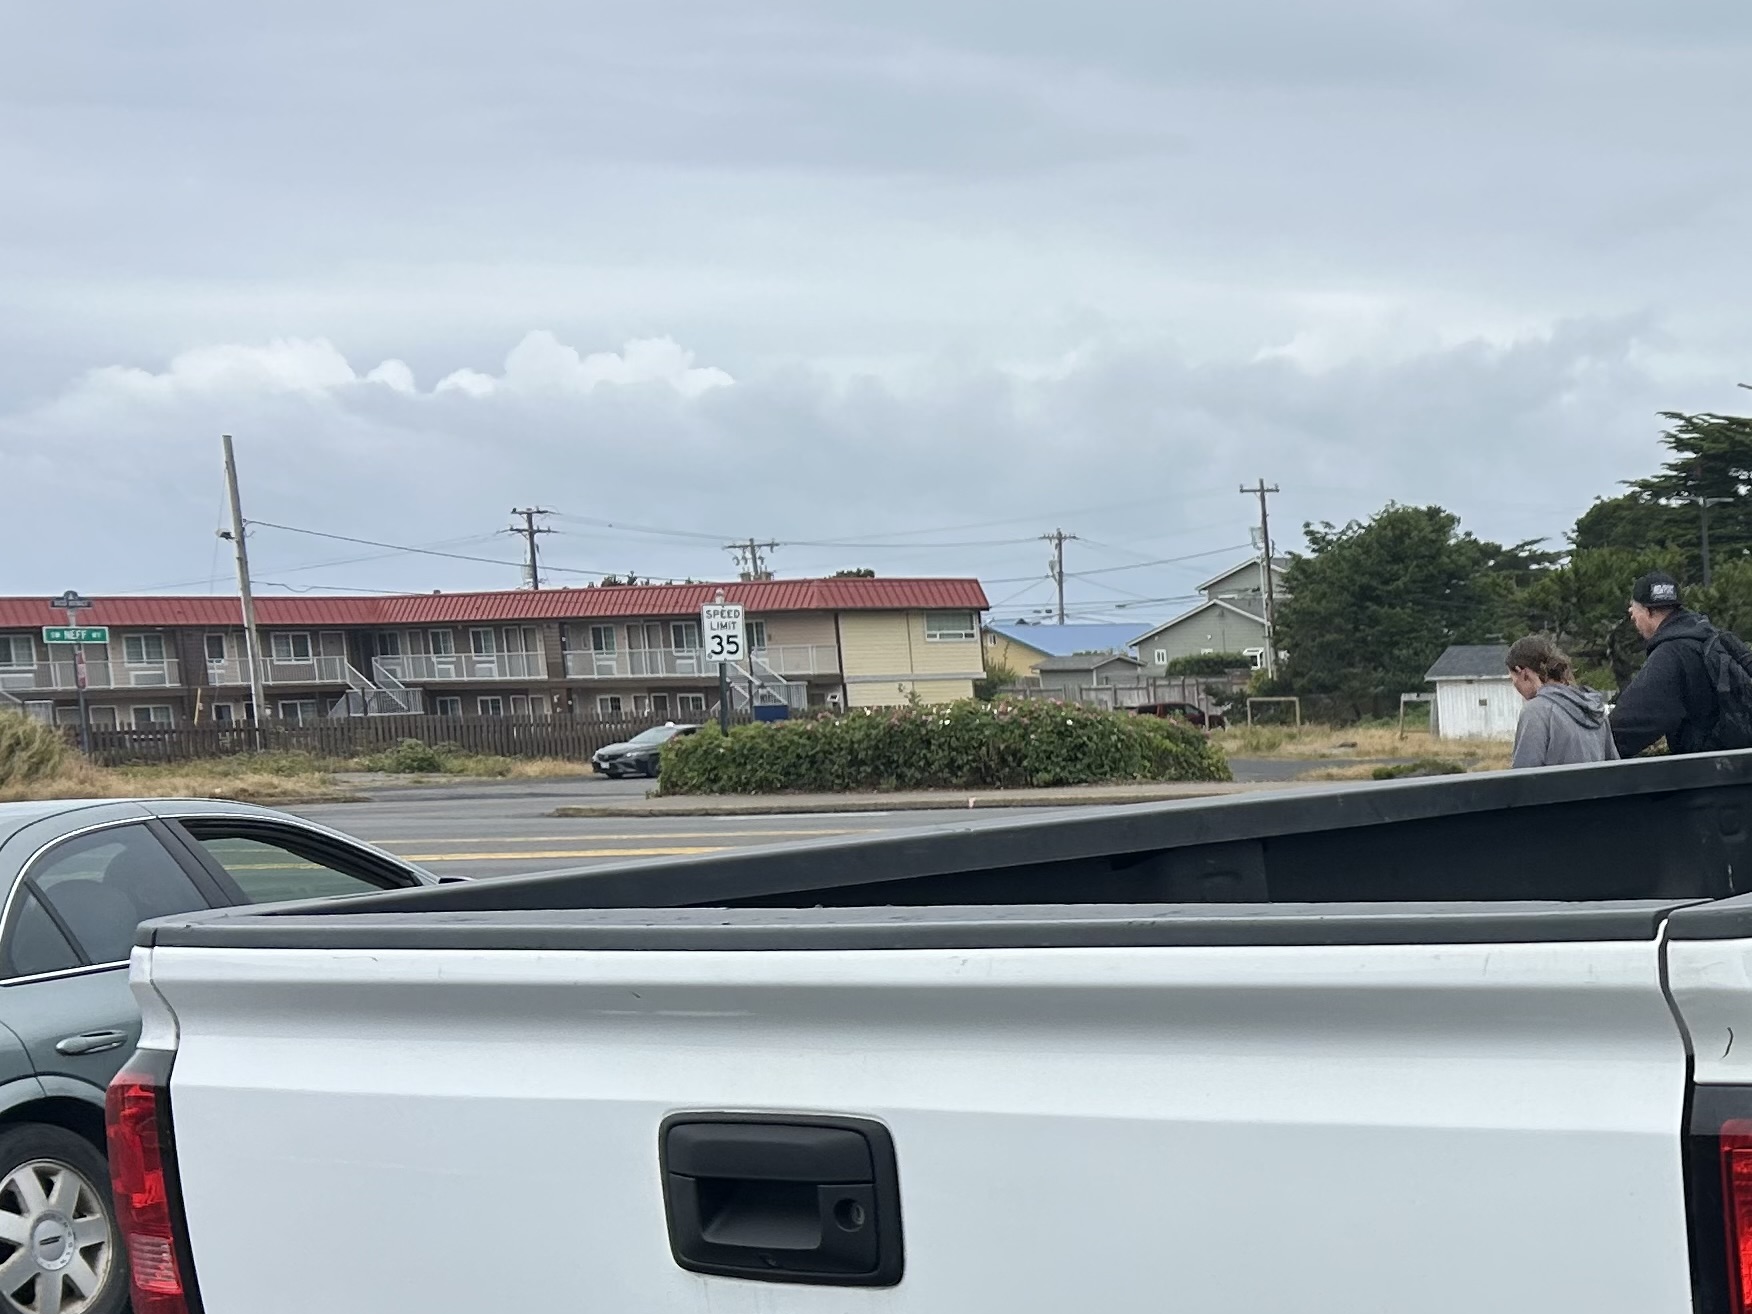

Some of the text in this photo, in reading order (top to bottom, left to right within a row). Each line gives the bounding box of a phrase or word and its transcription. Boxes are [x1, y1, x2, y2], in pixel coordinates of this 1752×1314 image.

[705, 609, 741, 619] SPEED
[710, 621, 737, 631] LIMIT
[64, 630, 87, 640] NEFF
[711, 634, 739, 655] 35
